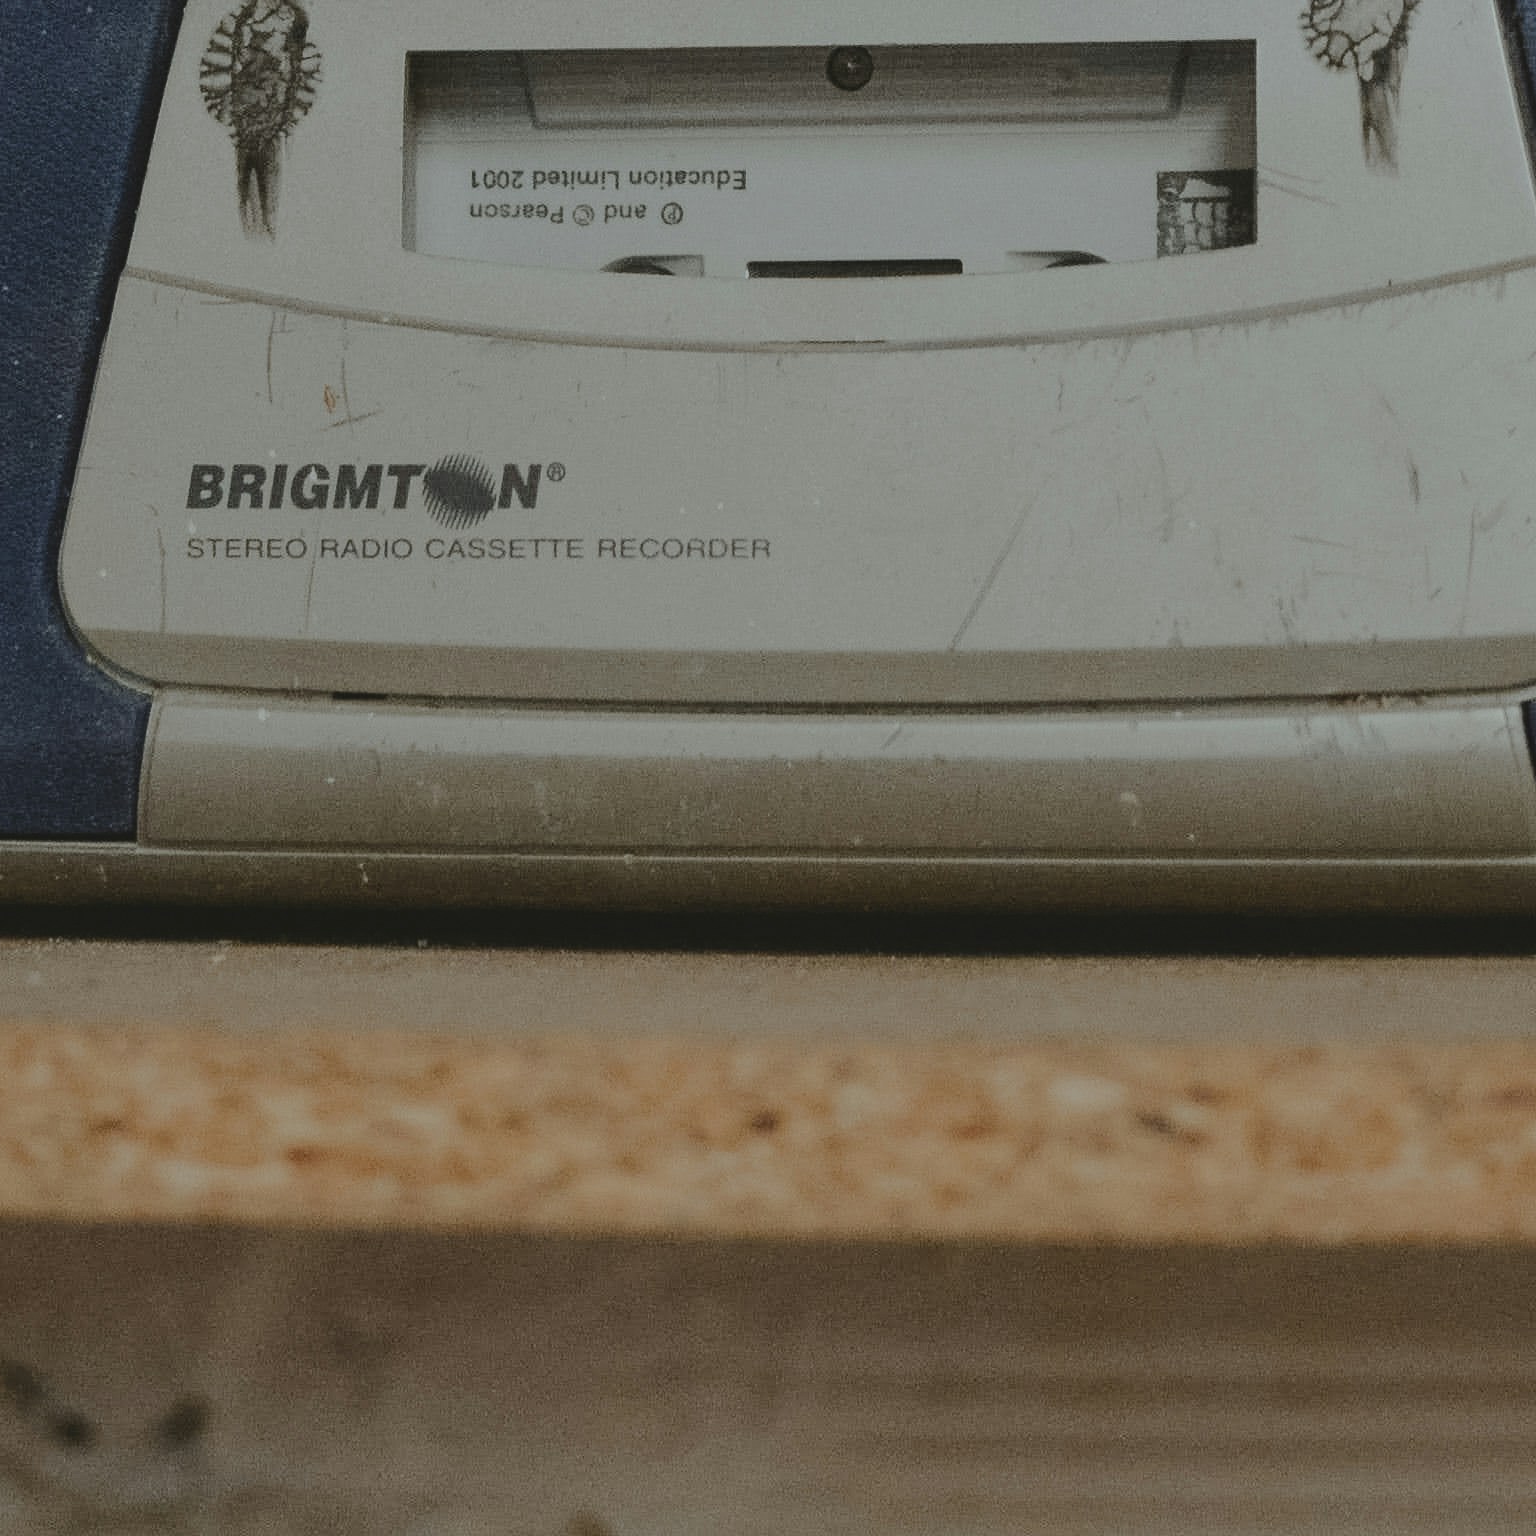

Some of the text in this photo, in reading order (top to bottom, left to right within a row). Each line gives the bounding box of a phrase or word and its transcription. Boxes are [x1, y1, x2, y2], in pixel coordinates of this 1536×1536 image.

[471, 169, 747, 191] Education Limited 2001
[469, 203, 564, 224] Pearson
[603, 203, 647, 225] and
[186, 537, 772, 560] STEREO RADIO CASSETTE RECORDER
